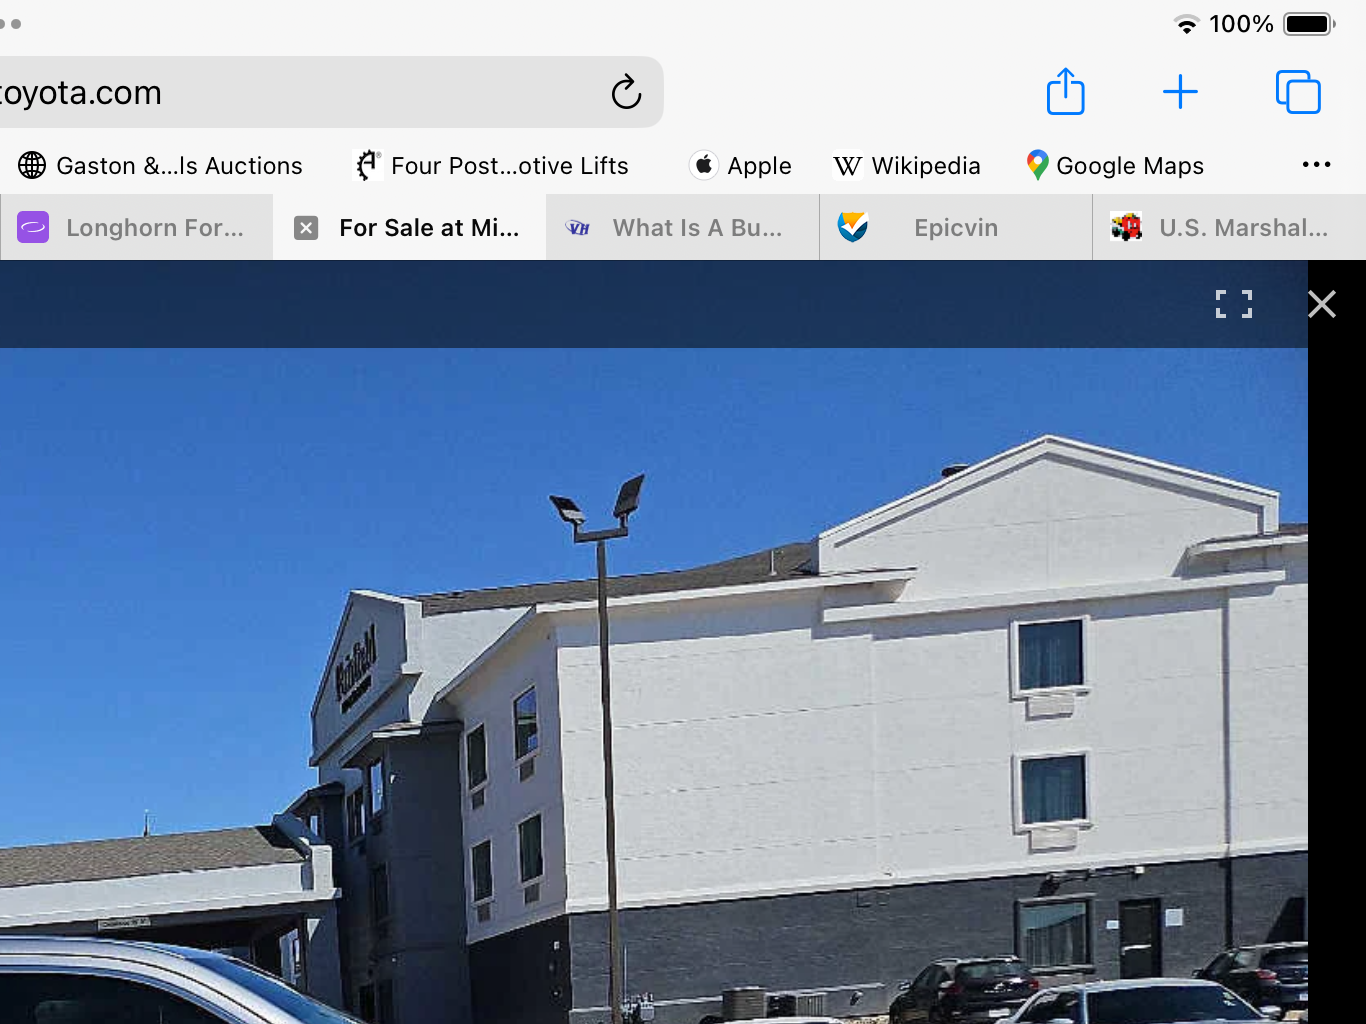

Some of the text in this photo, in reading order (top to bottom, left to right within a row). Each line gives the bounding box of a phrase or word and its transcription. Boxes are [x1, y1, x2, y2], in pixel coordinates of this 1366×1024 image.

[1210, 14, 1273, 33] 100%
[57, 156, 135, 175] Gaston
[205, 156, 302, 175] Auctions
[393, 157, 441, 175] Four
[582, 156, 628, 175] Lifts
[728, 156, 791, 179] Apple
[833, 157, 863, 176] W
[872, 156, 980, 179] Wikipedia
[1057, 156, 1204, 179] Google Maps
[68, 218, 176, 241] Longhorn
[341, 219, 377, 236] For
[385, 218, 433, 237] Sale
[441, 220, 463, 236] at
[613, 218, 672, 236] What
[682, 219, 700, 236] Is
[708, 219, 723, 236] A
[916, 218, 997, 240] Epicvin
[1161, 219, 1206, 236] U.S.
